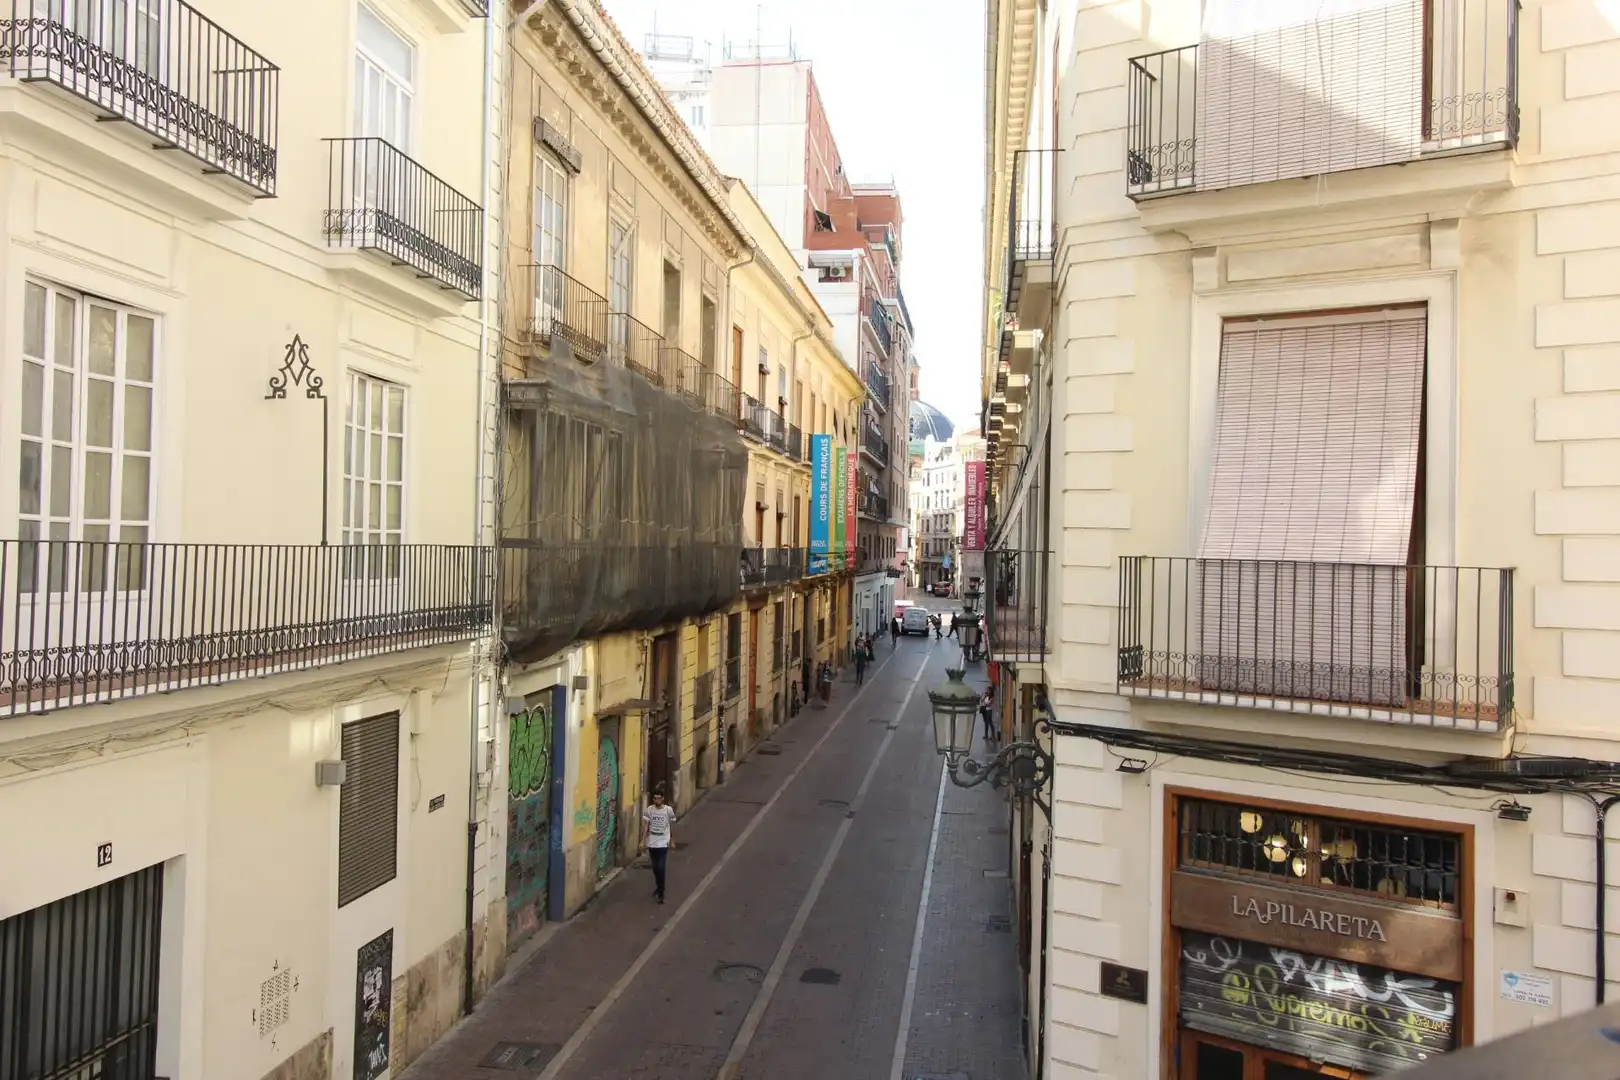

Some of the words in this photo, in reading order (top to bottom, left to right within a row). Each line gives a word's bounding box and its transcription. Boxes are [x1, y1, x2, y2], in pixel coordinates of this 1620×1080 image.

[820, 438, 829, 479] FRANÇAIS
[820, 481, 828, 492] DE
[820, 494, 828, 521] COURS
[837, 489, 845, 524] EXAMENS
[968, 498, 977, 524] ALQUILER
[967, 531, 976, 547] VENTA
[99, 845, 111, 865] 12
